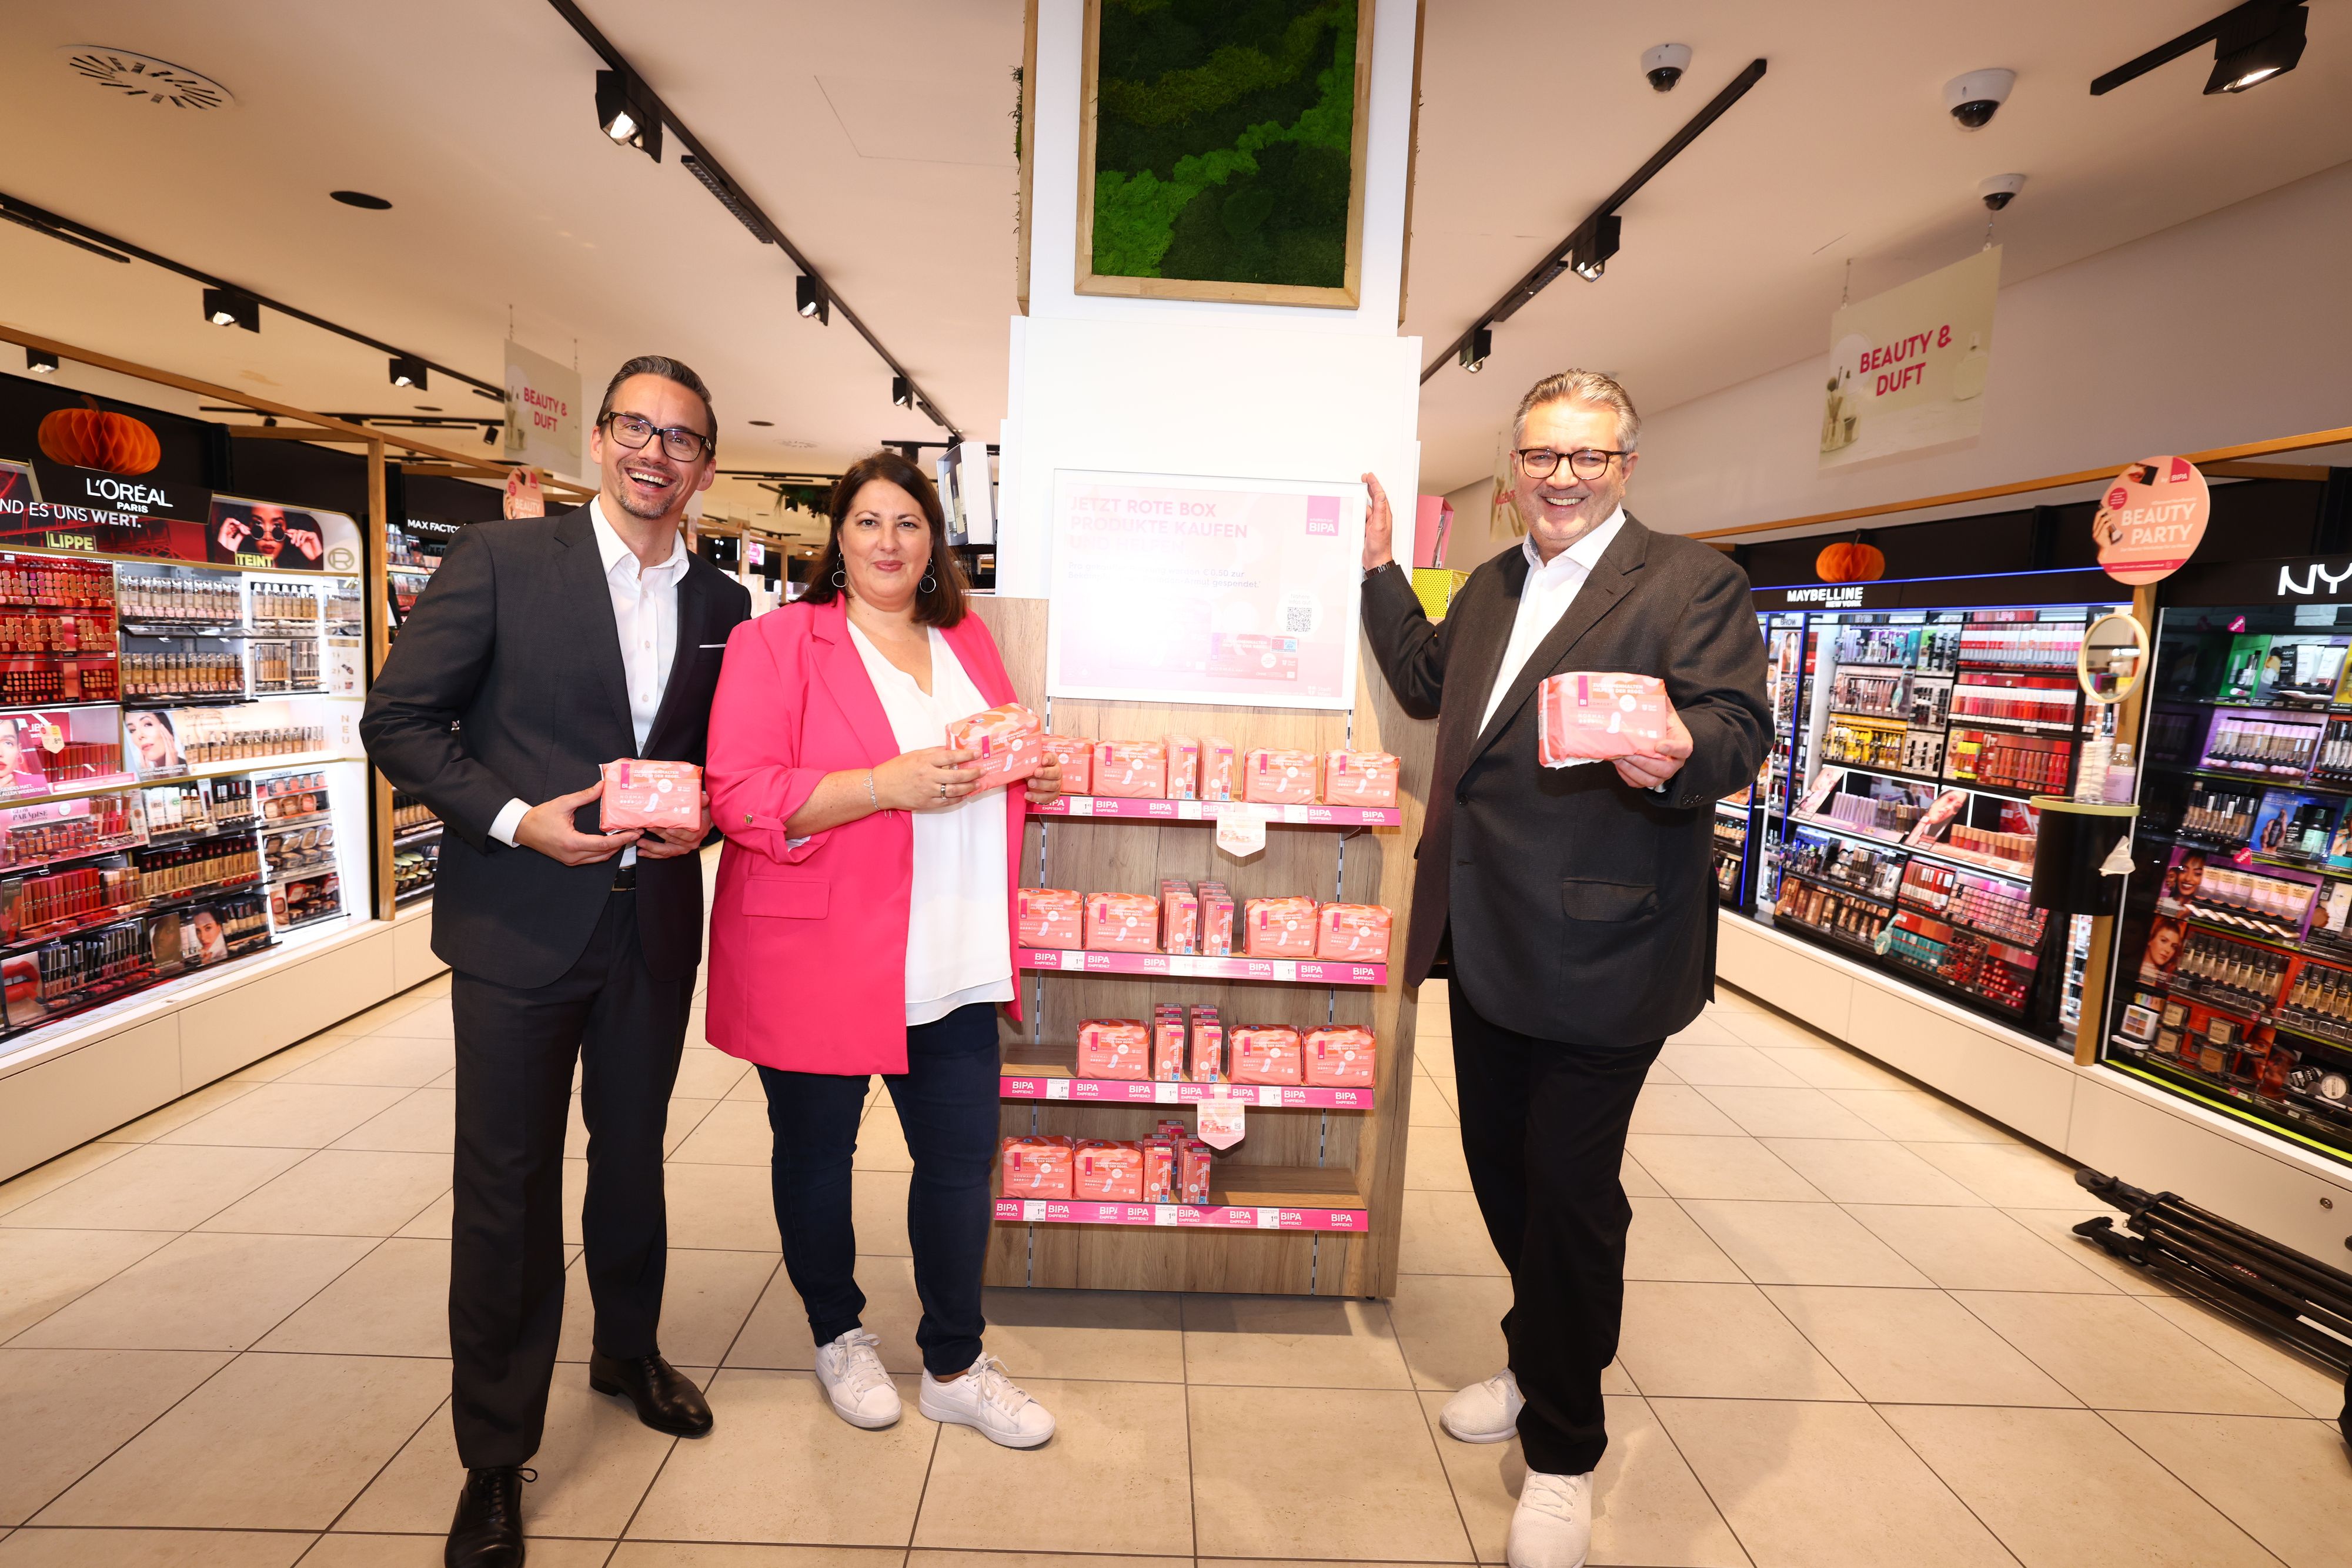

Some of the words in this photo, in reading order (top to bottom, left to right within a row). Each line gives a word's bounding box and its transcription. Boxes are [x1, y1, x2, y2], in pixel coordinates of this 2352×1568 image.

[1860, 330, 1933, 374] BEAUTY
[1938, 325, 1952, 348] &
[1876, 362, 1927, 396] DUFT
[523, 386, 559, 414] BEAUTY
[561, 404, 567, 416] &
[534, 411, 558, 432] DUFT
[2171, 473, 2188, 482] BIPA
[515, 498, 540, 513] BEAUTY
[1071, 497, 1121, 513] JETZT
[1127, 500, 1173, 516] ROTE
[1180, 503, 1217, 517] BOX
[29, 503, 49, 517] ES
[54, 504, 88, 522] UNS
[91, 509, 142, 528] WERT.
[2122, 503, 2197, 526] BEAUTY
[407, 519, 428, 530] MAX
[430, 522, 461, 533] FACTO
[1071, 516, 1168, 534] PRODUKTE
[1174, 521, 1248, 539] KAUFEN
[1309, 522, 1337, 533] BIPA
[2131, 523, 2193, 544] PARTY
[49, 533, 94, 551] LIPPE
[238, 553, 273, 567] TEINT
[1787, 586, 1863, 602] MAYBELLINE
[2236, 851, 2250, 862] NEW
[1144, 958, 1166, 967] BIPA
[1301, 965, 1322, 973] BIPA
[1353, 967, 1375, 975] BIPA
[1012, 1081, 1034, 1089] BIPA
[1335, 1092, 1357, 1100] BIPA
[997, 1203, 1018, 1212] BIPA
[1128, 1208, 1149, 1216] BIPA
[1179, 1209, 1200, 1218] BIPA
